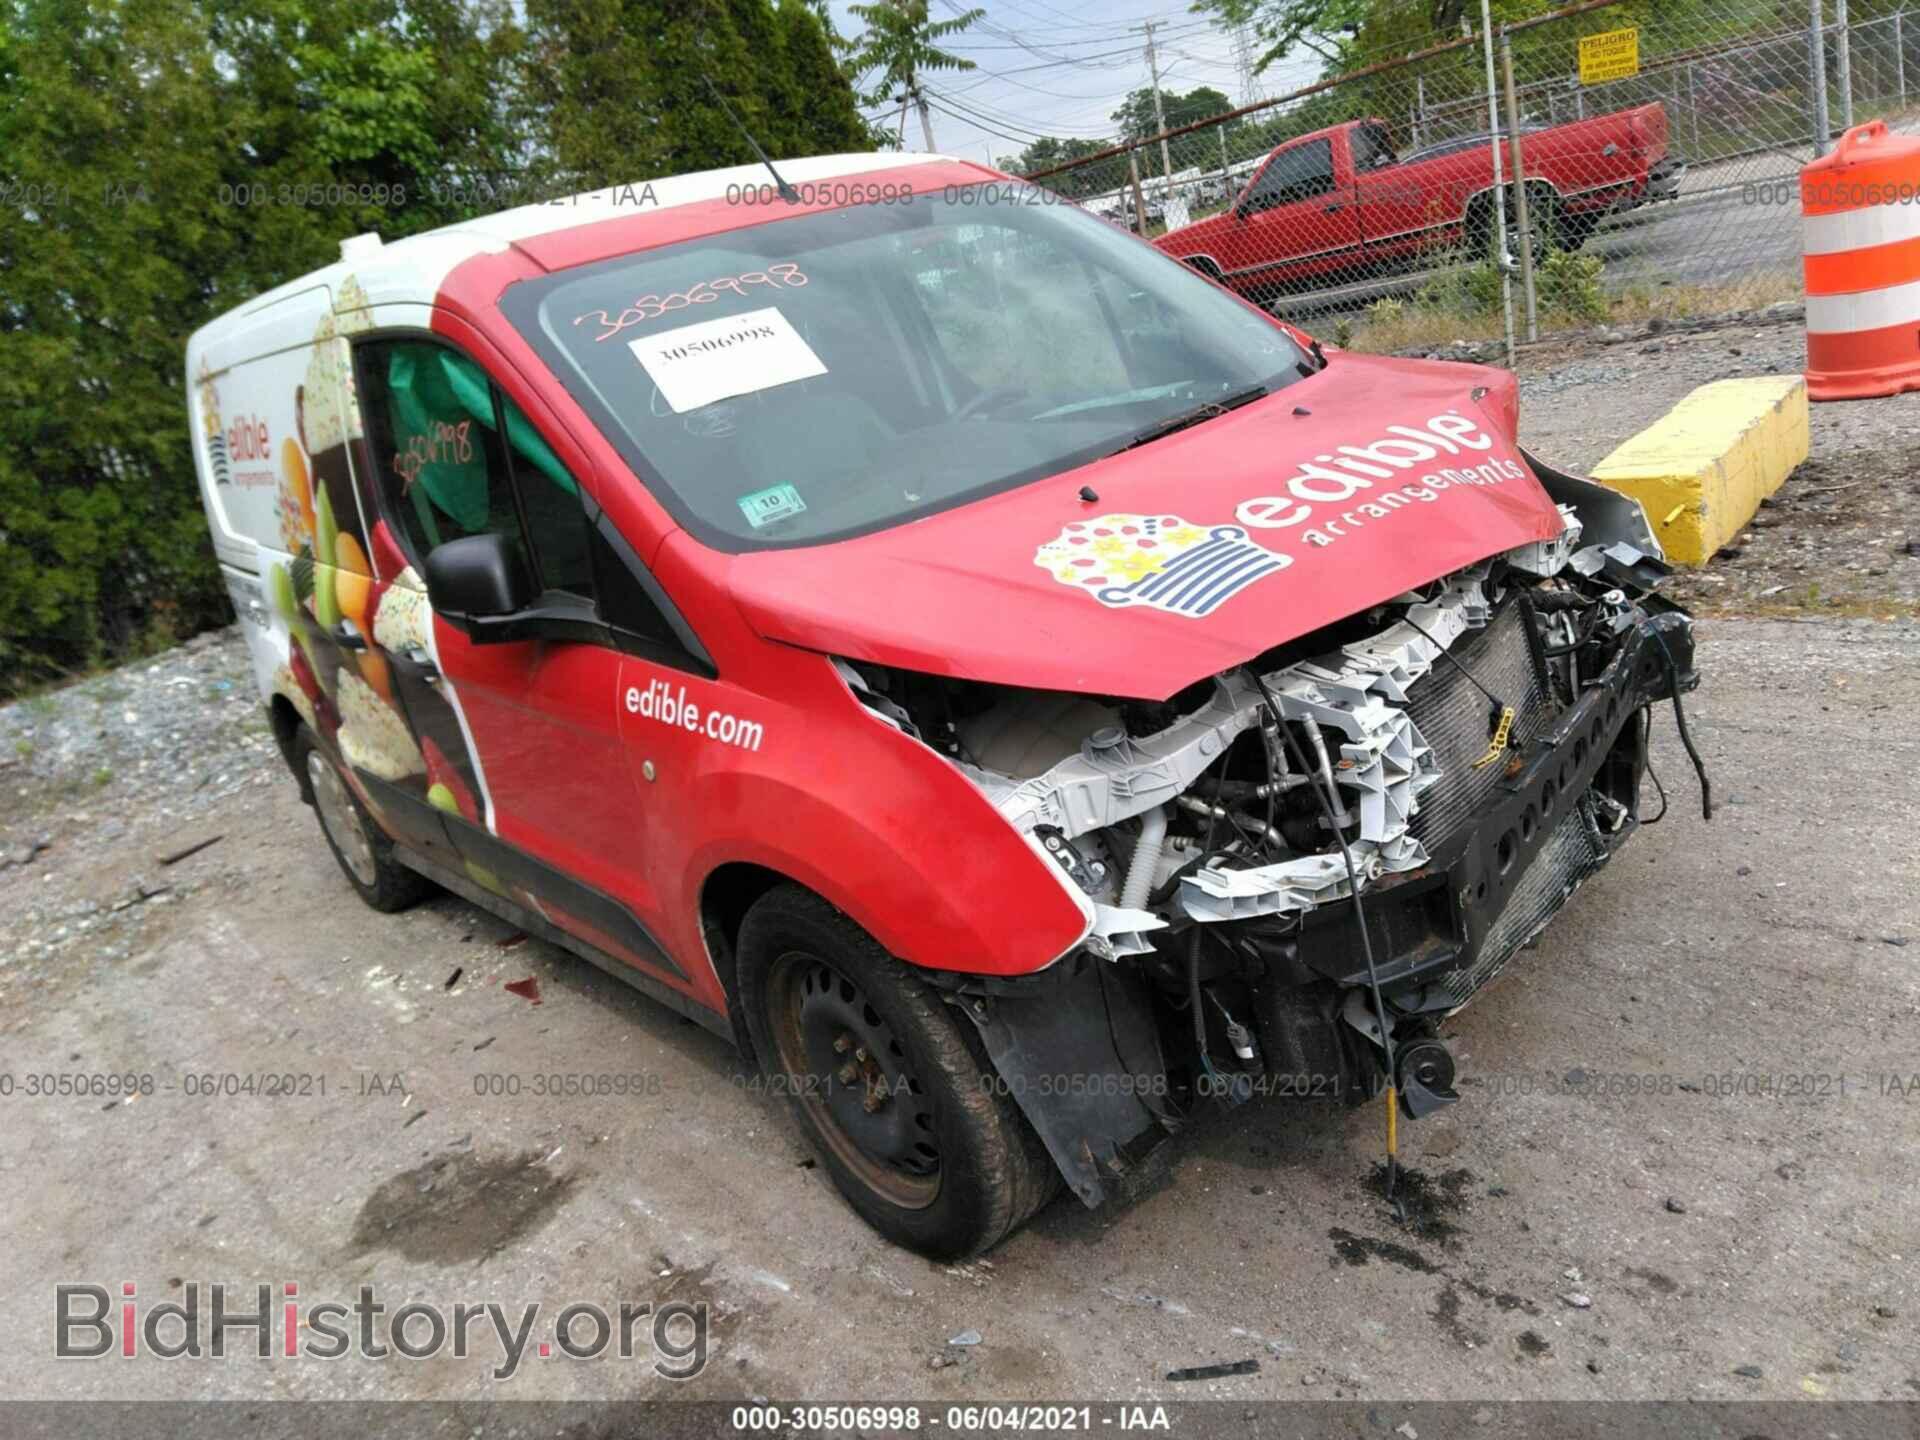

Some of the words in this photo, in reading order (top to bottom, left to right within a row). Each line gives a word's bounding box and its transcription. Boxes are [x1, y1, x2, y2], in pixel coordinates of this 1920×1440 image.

[1583, 31, 1636, 49] PELIGRO
[572, 263, 809, 343] 30506998
[658, 325, 776, 365] 30506998
[1233, 409, 1493, 529] edible
[1300, 455, 1526, 546] arrangements
[625, 678, 764, 752] edible.com
